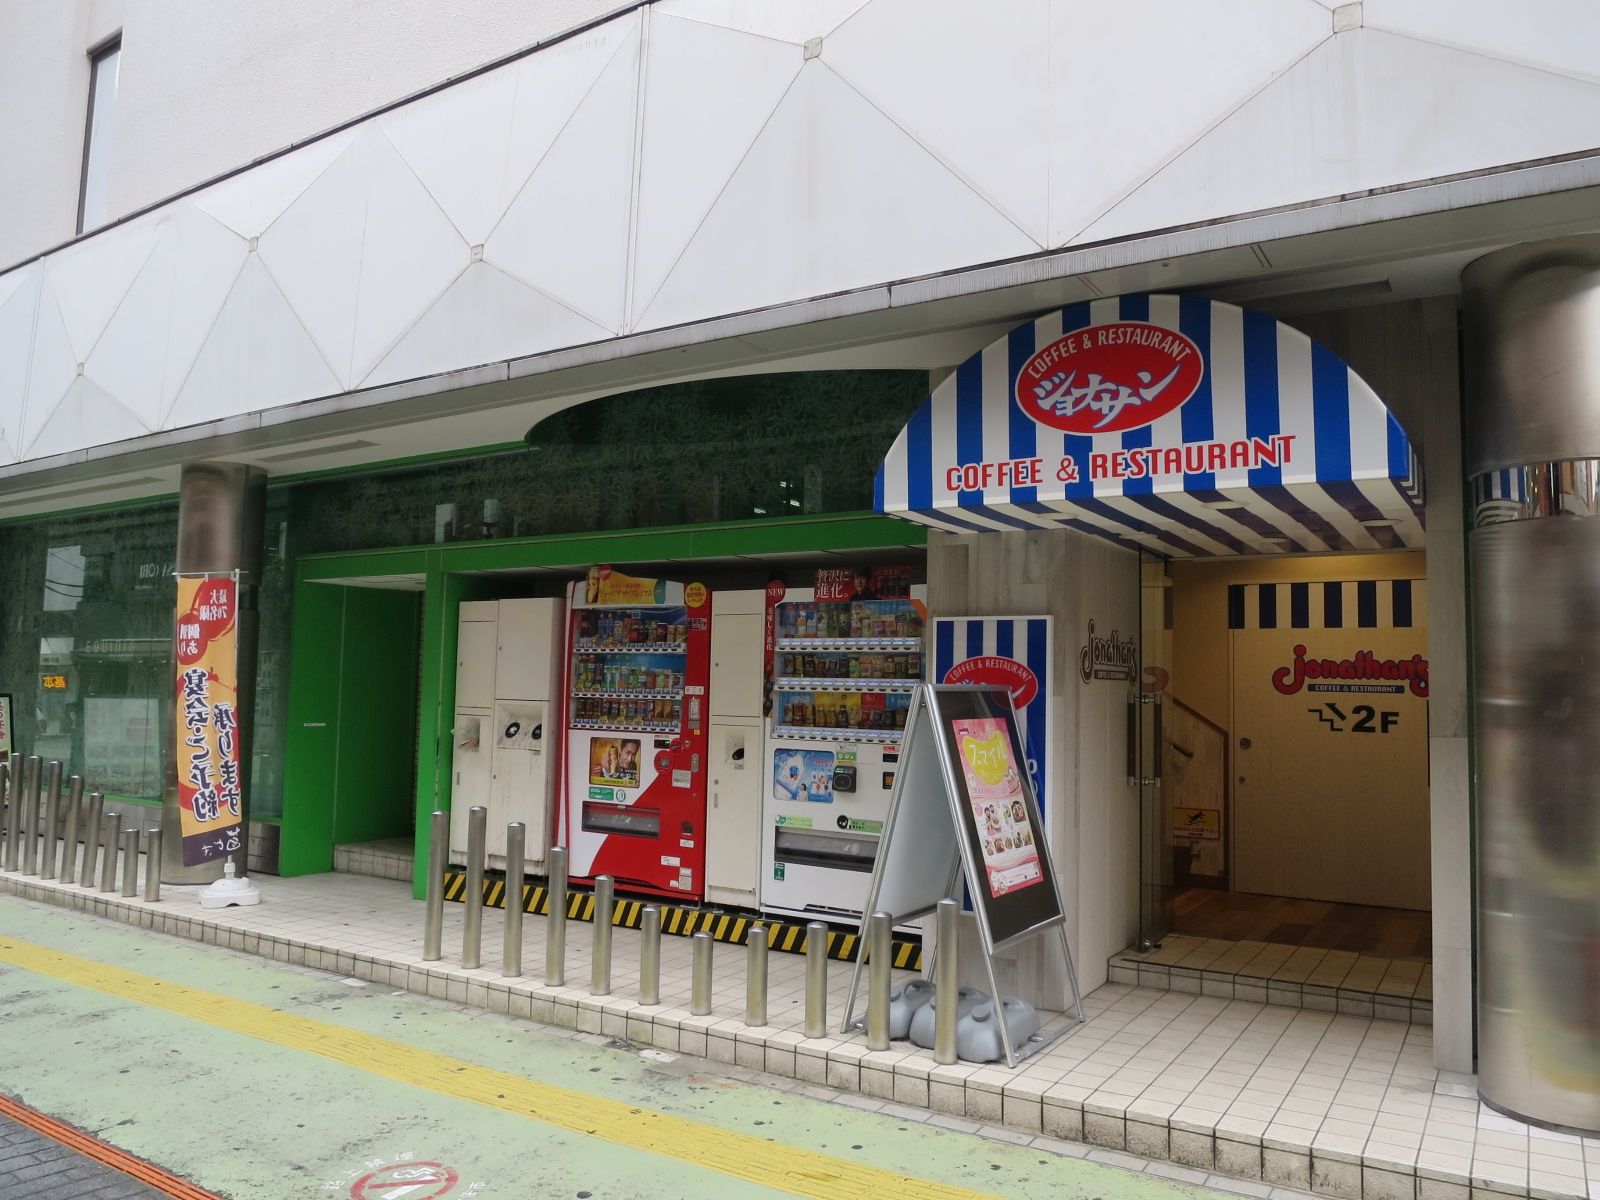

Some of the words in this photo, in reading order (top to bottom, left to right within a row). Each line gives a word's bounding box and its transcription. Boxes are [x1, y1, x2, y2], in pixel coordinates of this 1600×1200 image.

[1028, 338, 1077, 379] COFFEE
[1083, 333, 1092, 349] &
[1098, 328, 1191, 361] RESTAURANT
[1033, 364, 1181, 429] ジョナサン
[946, 458, 1043, 491] COFFEE
[1056, 454, 1079, 482] &
[1091, 435, 1296, 480] RESTAURANT
[817, 568, 849, 581] 贅沢に
[767, 588, 785, 597] NEW
[816, 583, 849, 598] 進化。
[950, 660, 975, 680] COFFEE
[977, 659, 983, 668] &
[986, 659, 1033, 681] RESTAURANT
[1351, 704, 1400, 733] 2F
